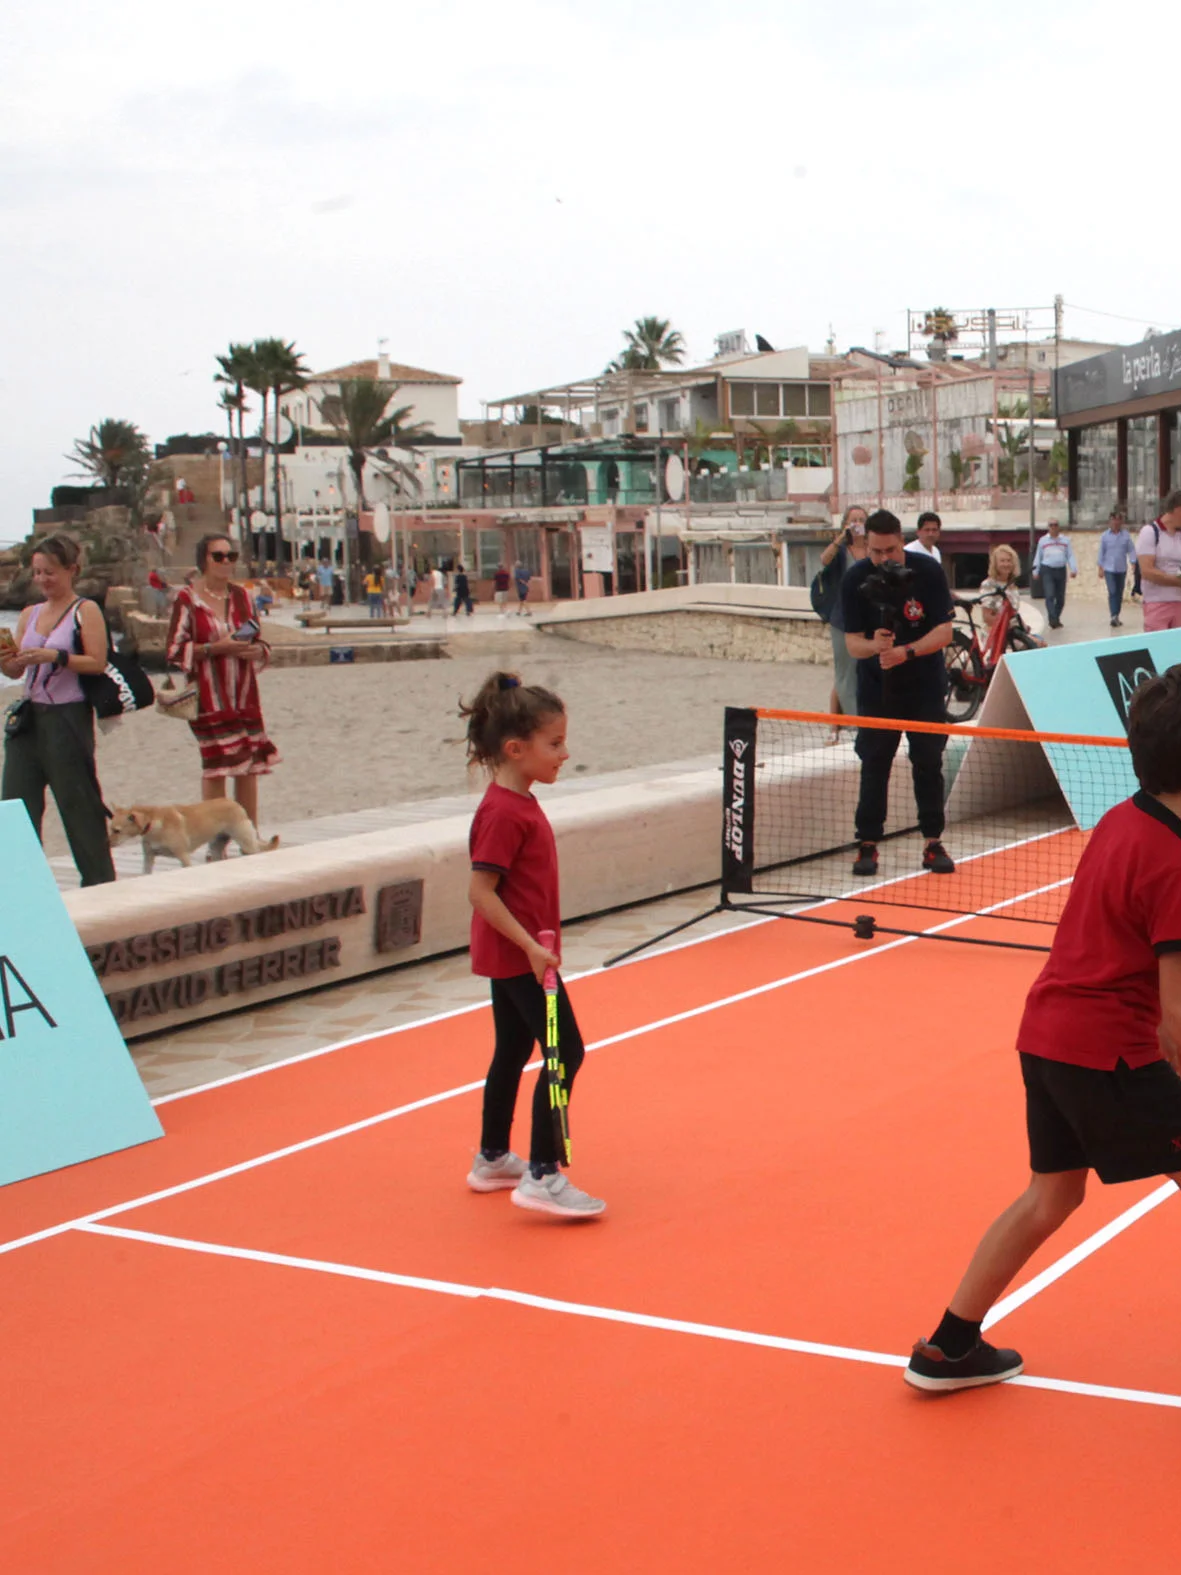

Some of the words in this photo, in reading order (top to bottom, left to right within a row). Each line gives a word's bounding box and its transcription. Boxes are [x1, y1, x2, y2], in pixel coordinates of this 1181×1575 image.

[1122, 352, 1133, 384] la
[1133, 345, 1161, 391] perla
[732, 759, 745, 864] DUNLOP
[85, 915, 233, 978] PASSEIG
[106, 973, 209, 1023] DAVID
[214, 935, 342, 997] FERRER
